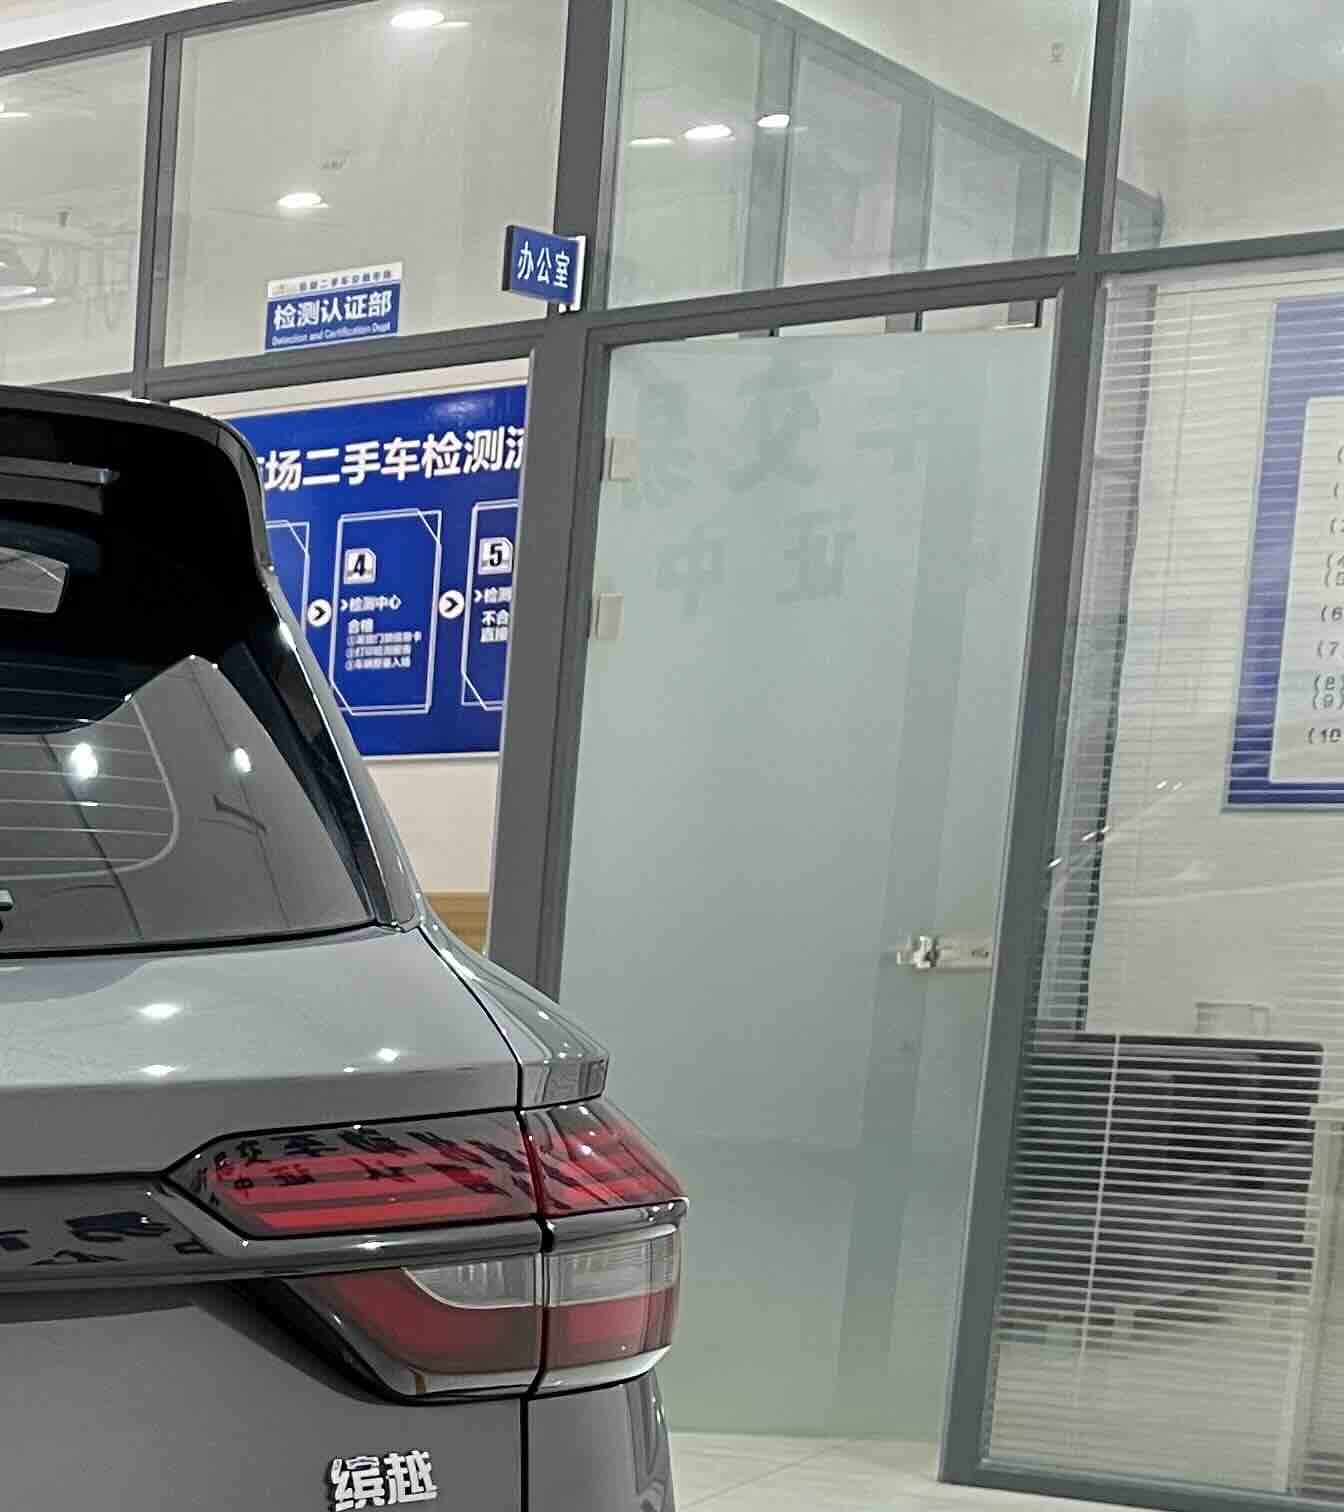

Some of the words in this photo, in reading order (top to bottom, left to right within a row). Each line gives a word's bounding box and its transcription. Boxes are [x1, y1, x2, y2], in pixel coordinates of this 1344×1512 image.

[515, 240, 571, 290] 办公室
[273, 290, 393, 331] 检测认证部
[256, 426, 526, 493] 场二手车检测
[352, 554, 367, 578] 4
[489, 543, 503, 567] 5
[330, 1450, 439, 1512] 缤越
